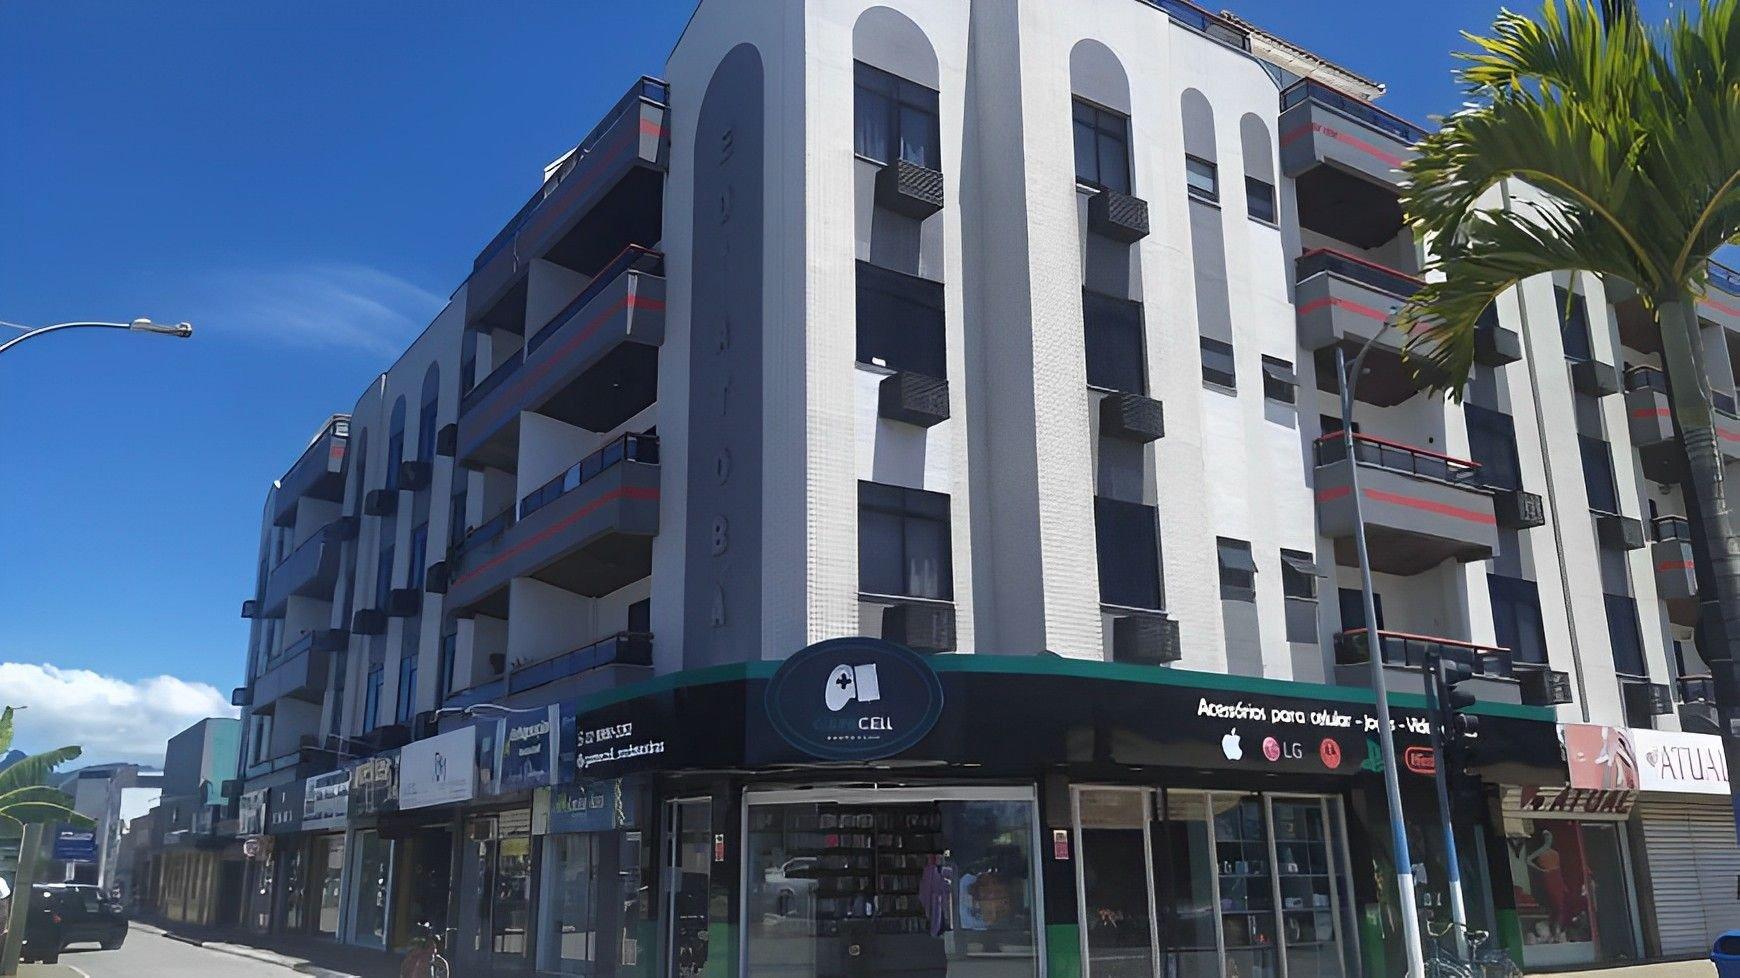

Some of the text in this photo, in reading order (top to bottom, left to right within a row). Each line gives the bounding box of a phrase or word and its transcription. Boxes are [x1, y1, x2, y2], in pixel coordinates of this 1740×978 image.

[1197, 697, 1267, 721] Acessórios
[1271, 709, 1306, 724] para
[1310, 709, 1352, 728] celular
[858, 716, 893, 731] CELL
[1283, 741, 1303, 759] LG
